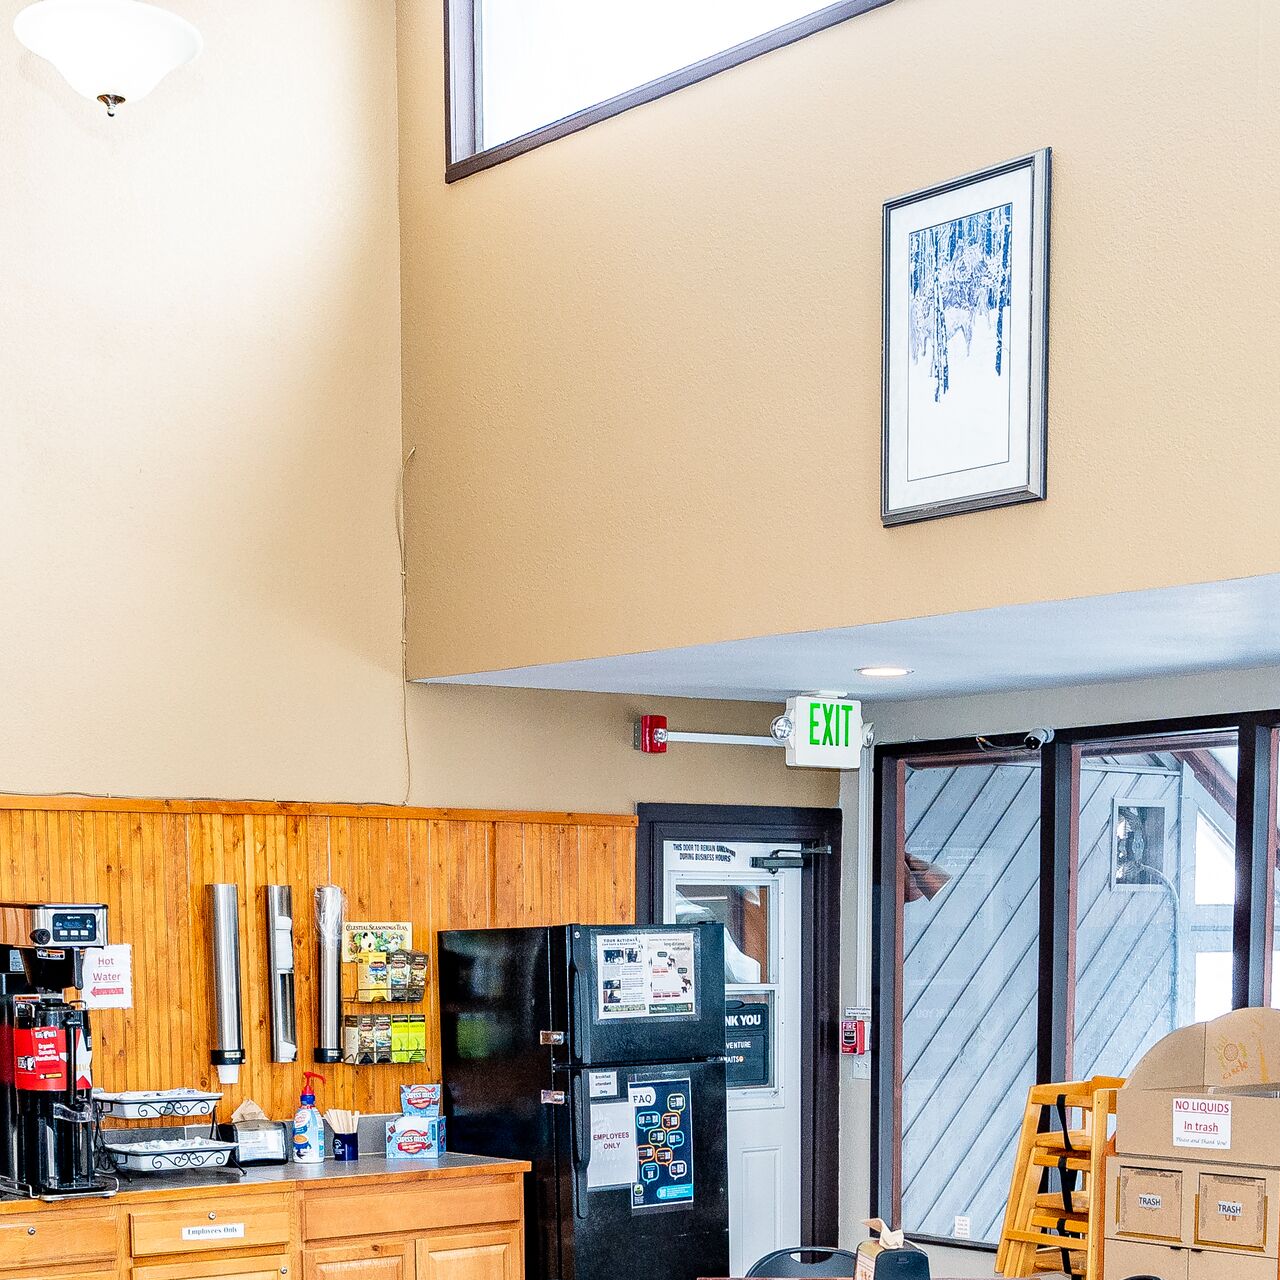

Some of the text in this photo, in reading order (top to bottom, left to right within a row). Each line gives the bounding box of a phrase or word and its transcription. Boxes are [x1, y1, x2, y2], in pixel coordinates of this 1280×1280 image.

[809, 702, 853, 747] EXIT
[673, 843, 682, 851] THIS
[700, 844, 716, 852] REMAIN
[680, 852, 732, 863] DURING BUSINESS HOURS
[98, 957, 114, 965] Hot
[92, 972, 121, 981] Water
[740, 1014, 761, 1026] YOU
[842, 1022, 857, 1030] FIRE
[725, 1041, 751, 1049] VENTURE
[633, 1094, 652, 1104] FAQ
[1175, 1100, 1230, 1114] NO LIQUIDS
[1184, 1120, 1219, 1132] In trash
[593, 1131, 629, 1141] EMPLOYEES
[603, 1142, 621, 1150] ONLY
[1139, 1196, 1161, 1206] TRASH
[1217, 1203, 1242, 1214] TRASH
[187, 1227, 222, 1236] Employees
